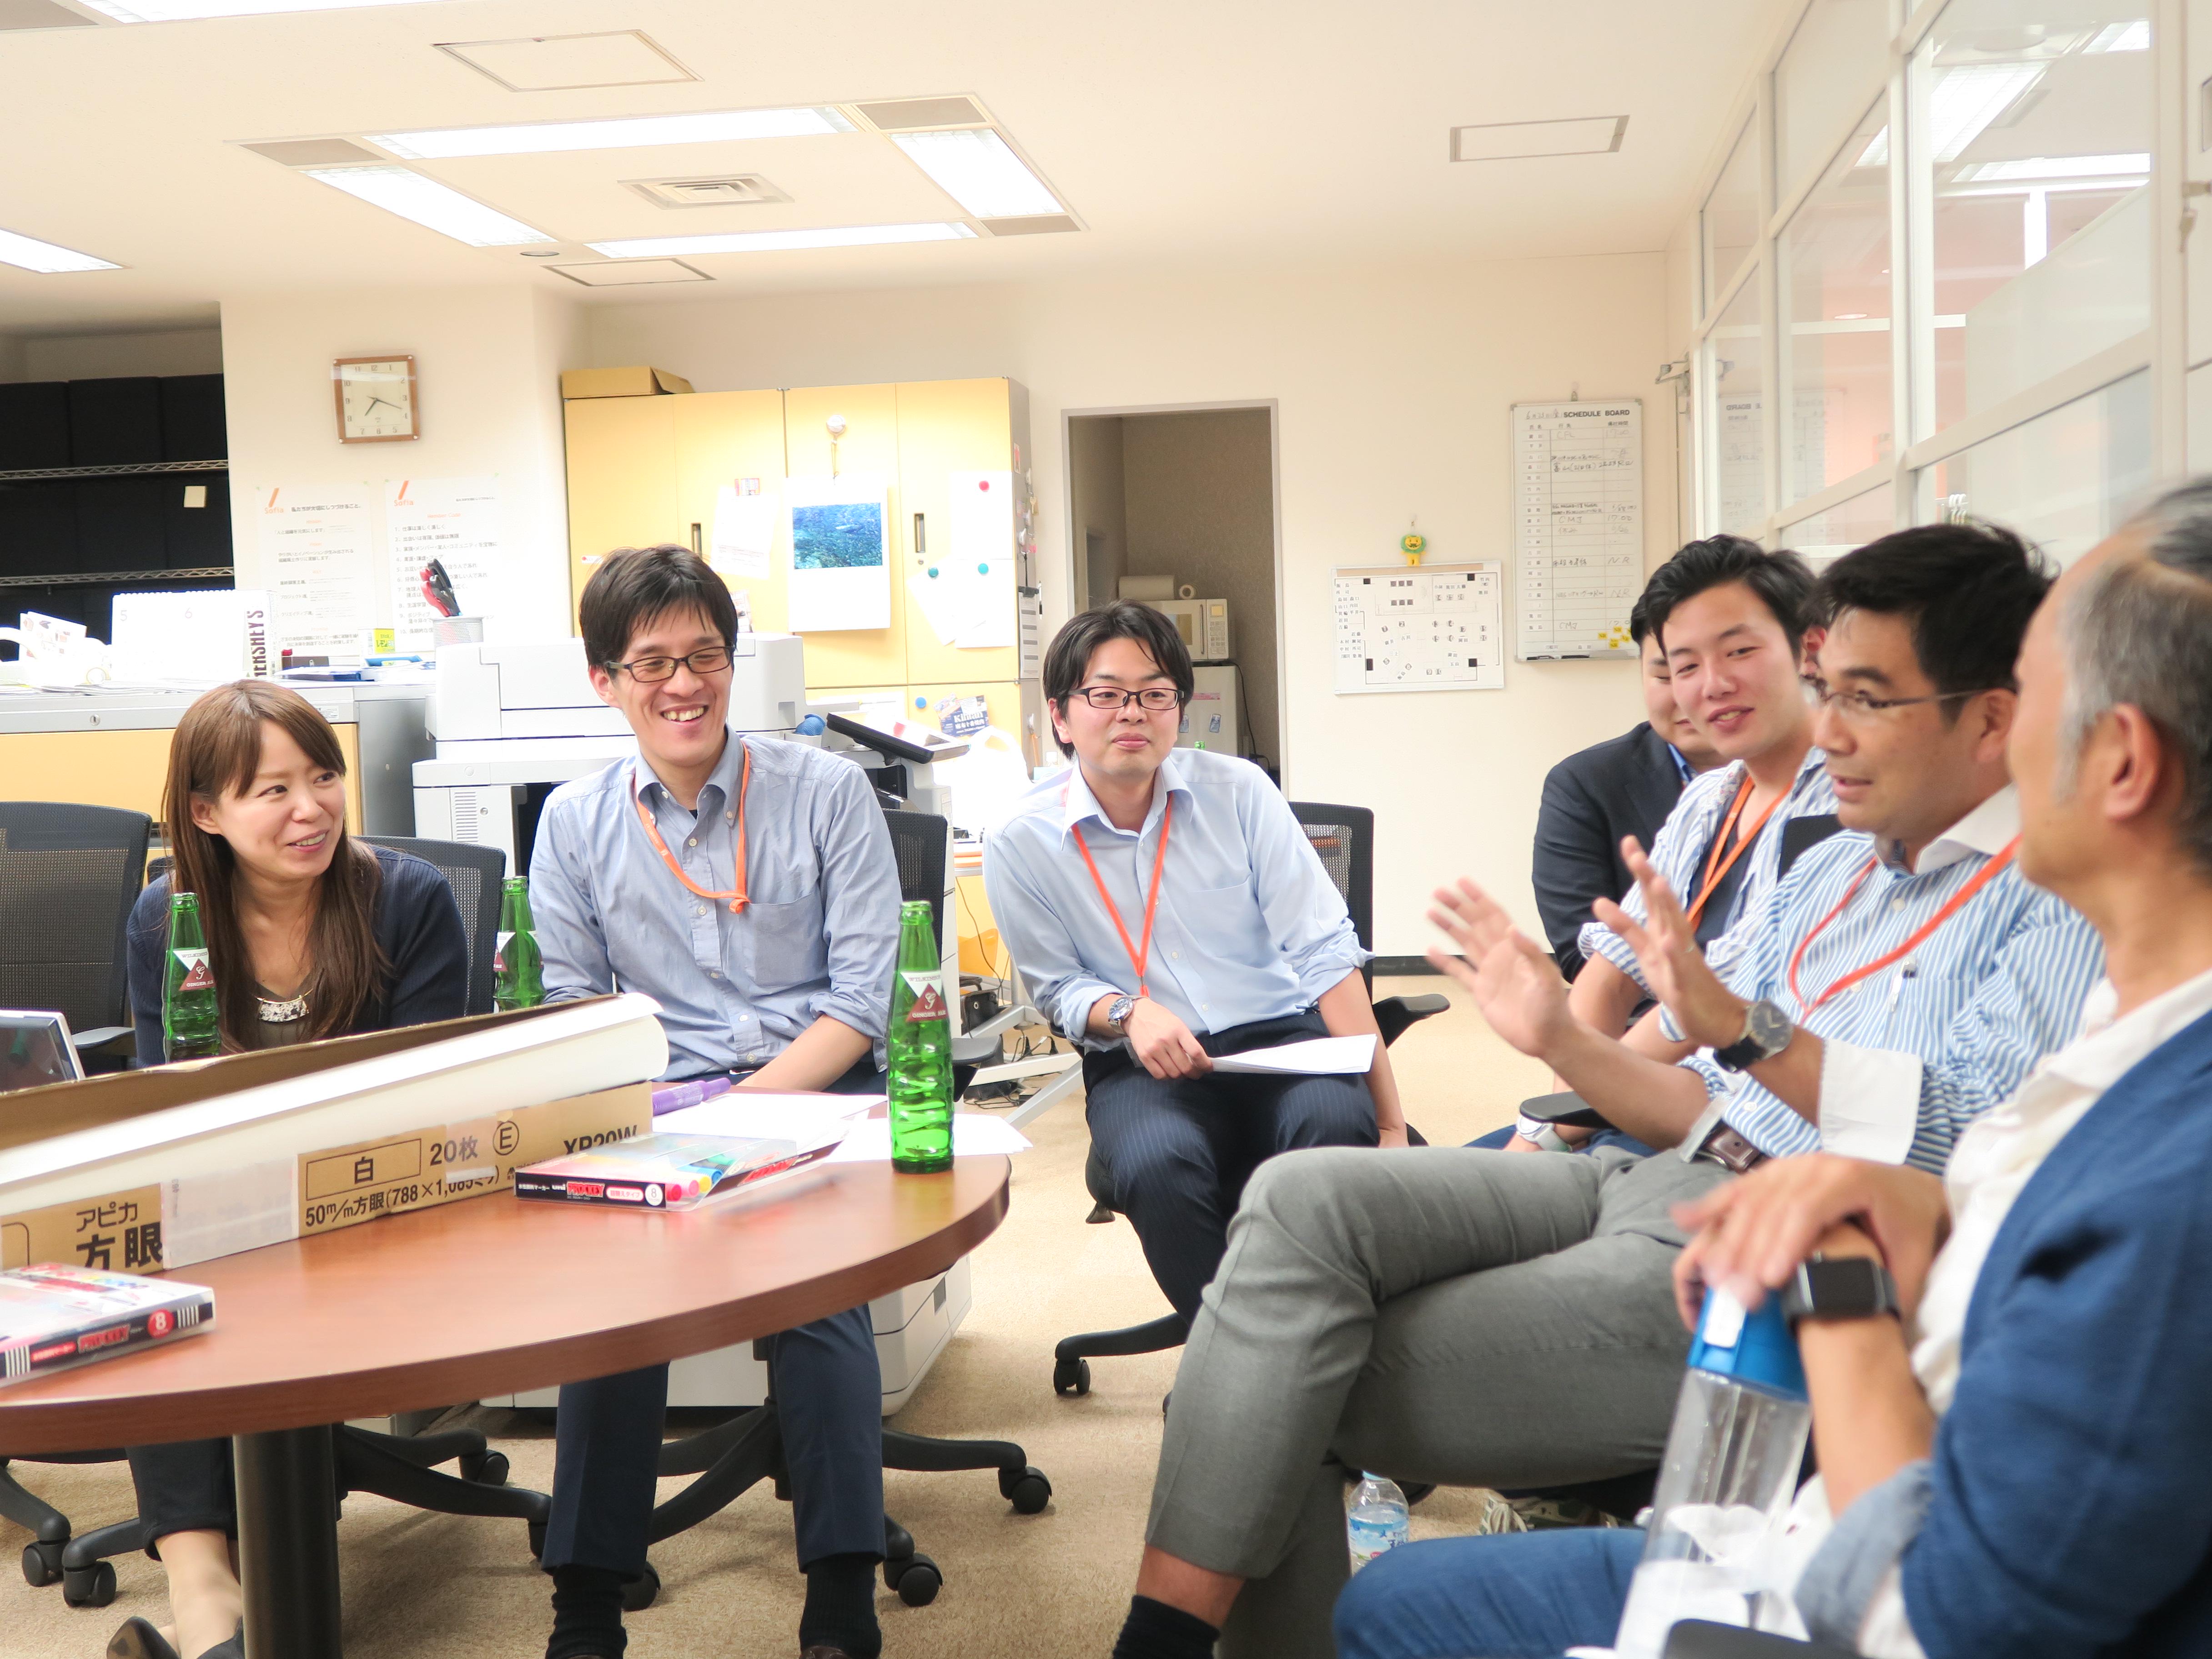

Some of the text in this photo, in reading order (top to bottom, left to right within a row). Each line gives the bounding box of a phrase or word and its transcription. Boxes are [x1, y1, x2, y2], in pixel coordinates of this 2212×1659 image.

[120, 610, 127, 621] 5
[185, 608, 192, 618] 6
[196, 966, 205, 980] G
[925, 993, 936, 1010] G
[430, 1136, 478, 1166] 20枚
[354, 1156, 373, 1184] 白
[567, 1181, 605, 1198] PROCKEY
[651, 1188, 657, 1198] 8
[76, 1202, 138, 1232] アピカ
[76, 1221, 162, 1270] 方眼
[78, 1324, 131, 1354] PROCKEY
[154, 1312, 167, 1330] 8
